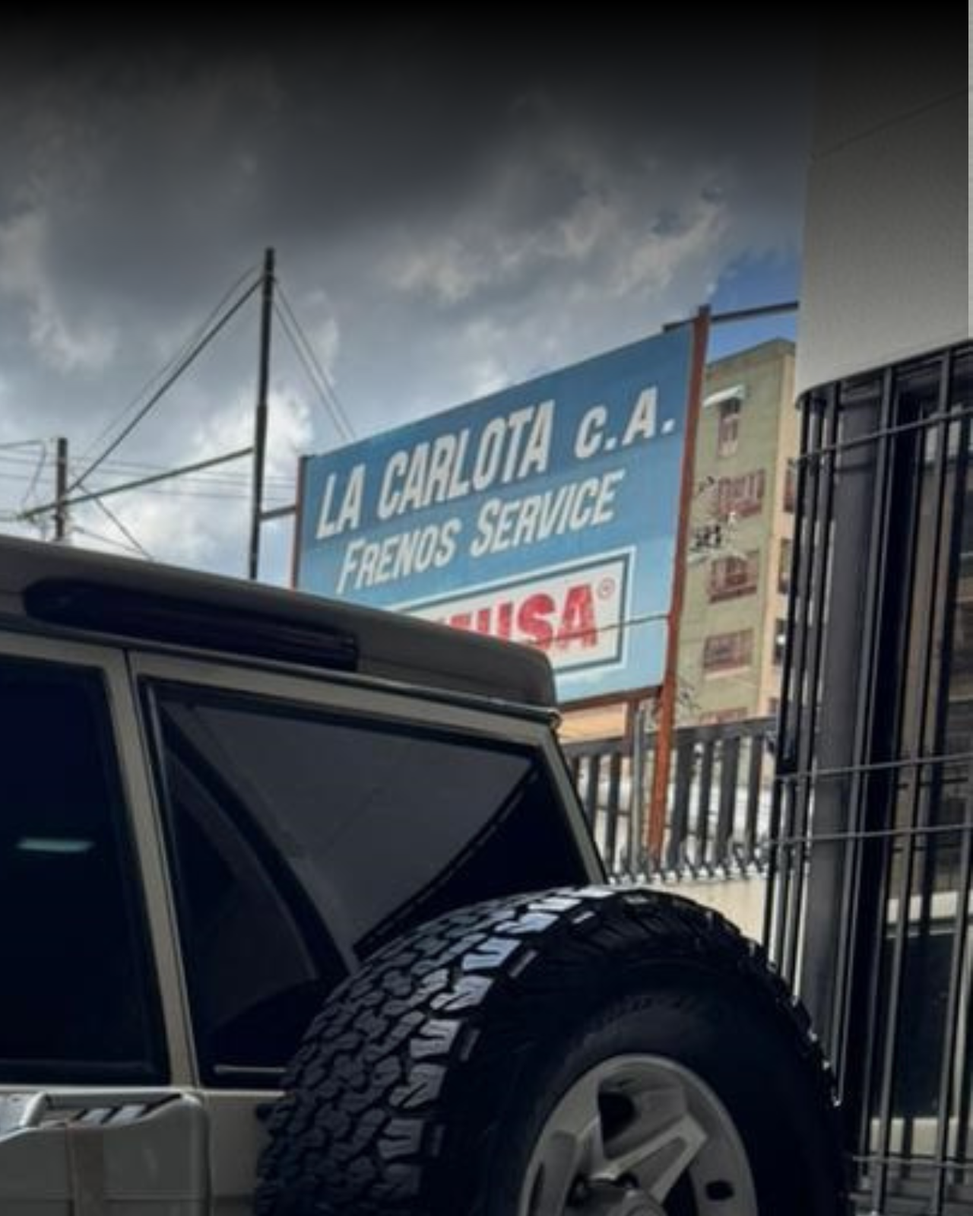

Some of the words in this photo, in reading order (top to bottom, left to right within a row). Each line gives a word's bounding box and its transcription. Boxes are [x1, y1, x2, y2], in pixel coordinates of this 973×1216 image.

[317, 465, 364, 539] LA
[377, 400, 555, 520] CARLOTA
[575, 387, 674, 459] C.A.
[336, 520, 461, 595] FRENOS
[470, 469, 625, 558] SERVICE
